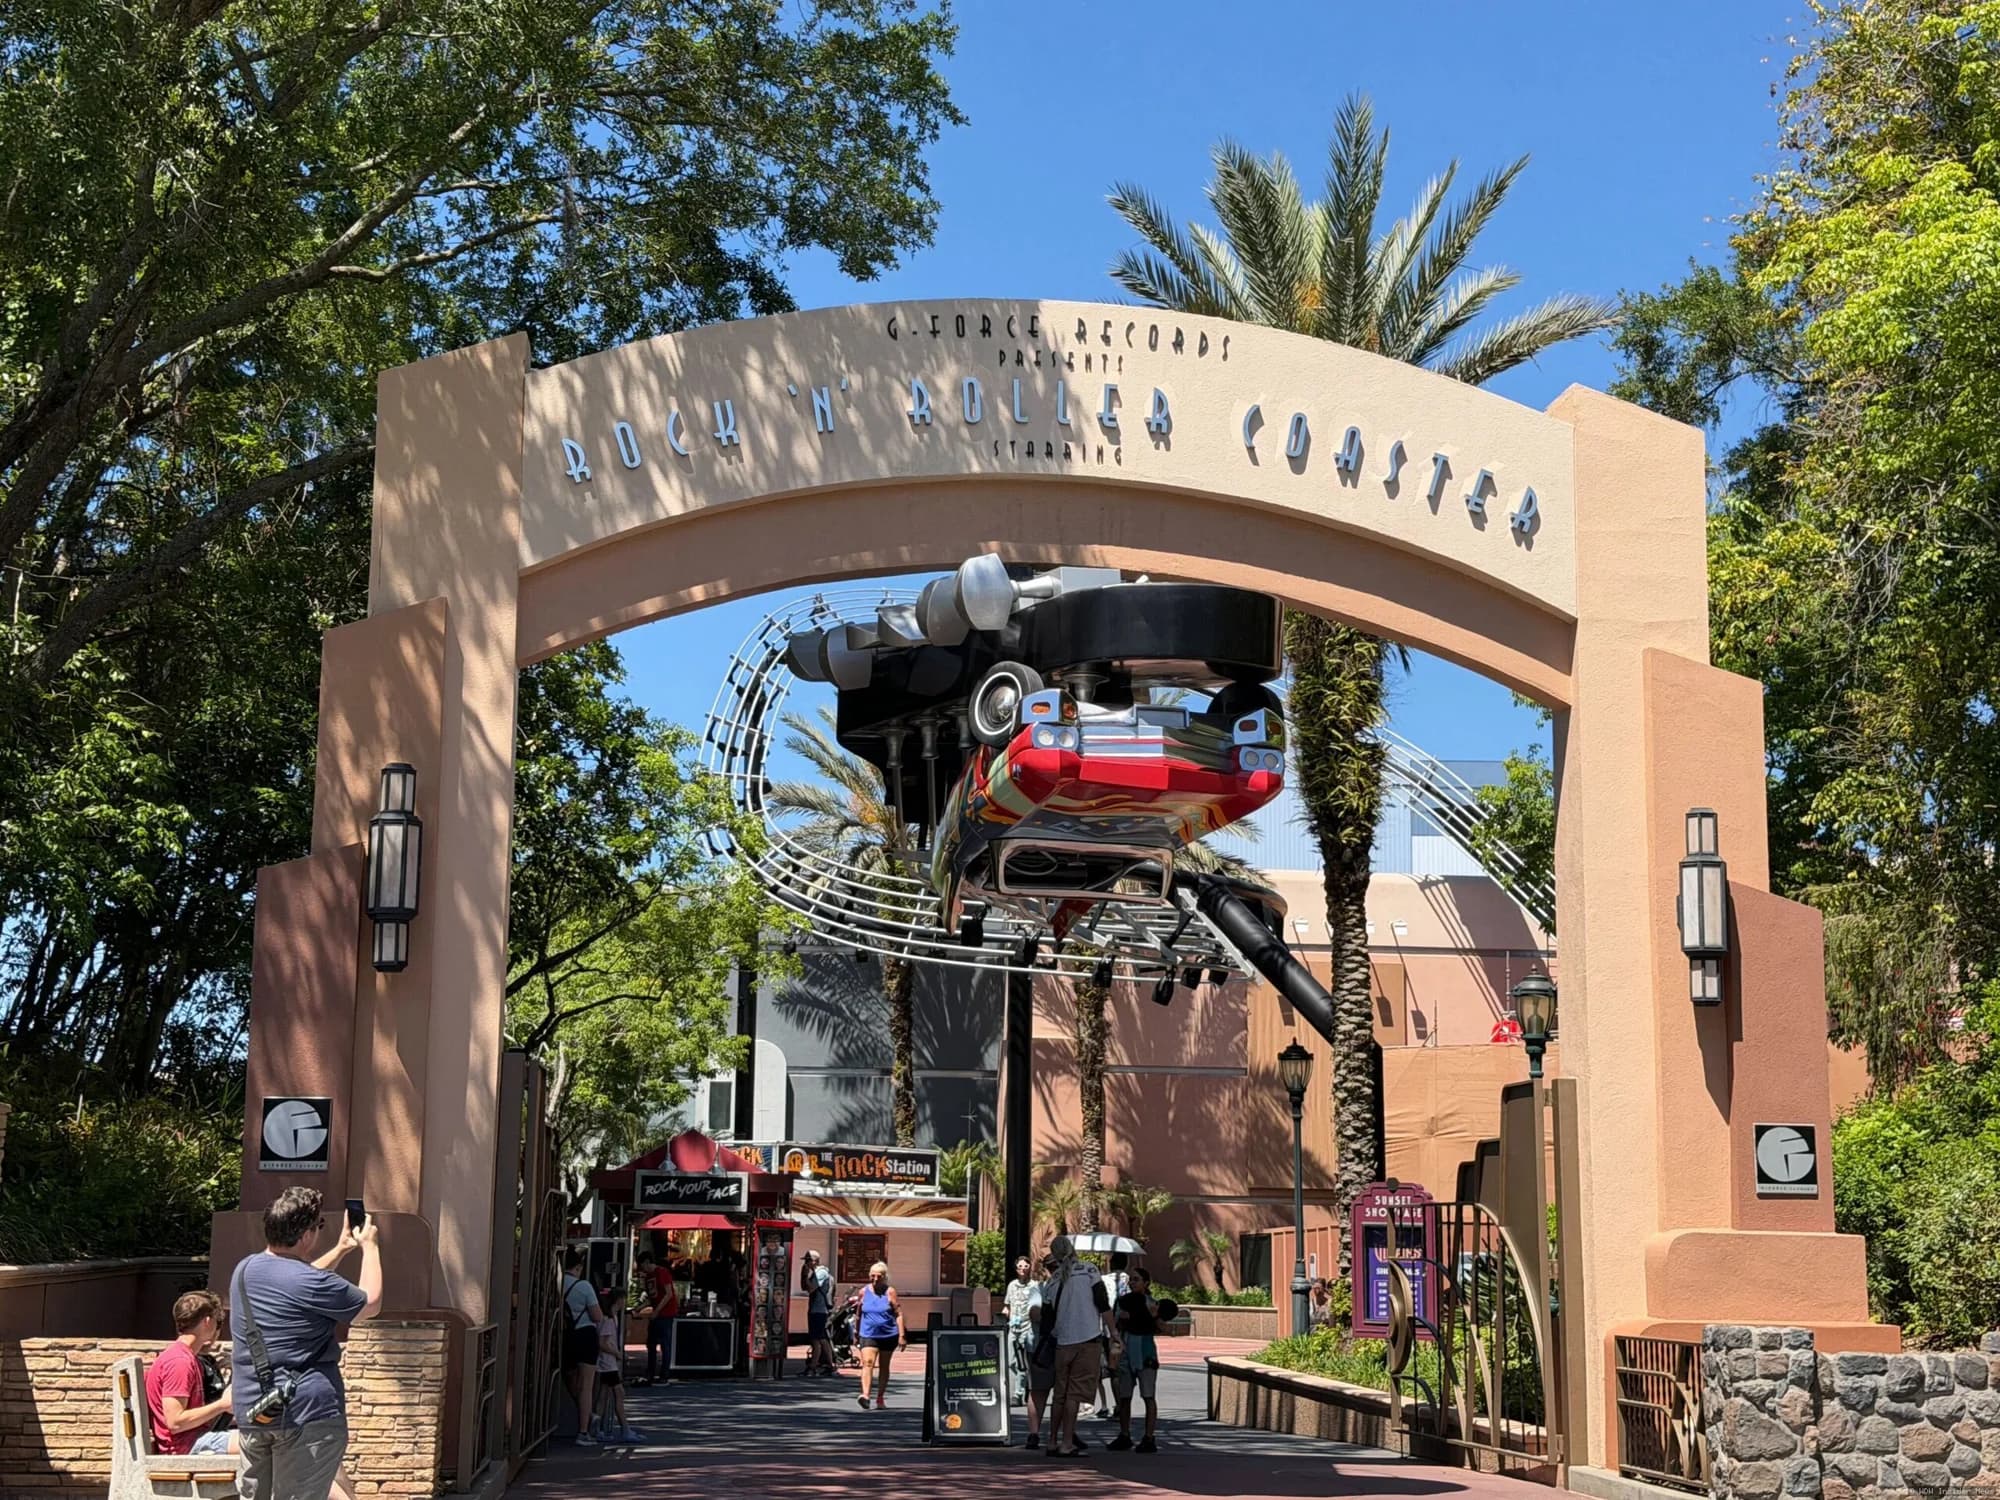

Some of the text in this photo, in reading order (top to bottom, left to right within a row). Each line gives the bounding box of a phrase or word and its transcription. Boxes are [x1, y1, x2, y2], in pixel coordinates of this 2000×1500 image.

[887, 314, 1231, 361] G-FORCE RECORDS
[999, 349, 1124, 375] PRESENTS
[561, 399, 741, 484] ROCK
[907, 377, 1173, 434] ROLLER
[1242, 403, 1538, 534] COASTER
[993, 440, 1123, 466] STARRING
[821, 1152, 833, 1161] THE
[835, 1153, 889, 1179] ROCK
[886, 1159, 931, 1175] Station
[644, 1179, 740, 1202] ROCK YOUR FACE
[1375, 1196, 1411, 1205] SUNSET
[971, 1367, 997, 1376] ALONG
